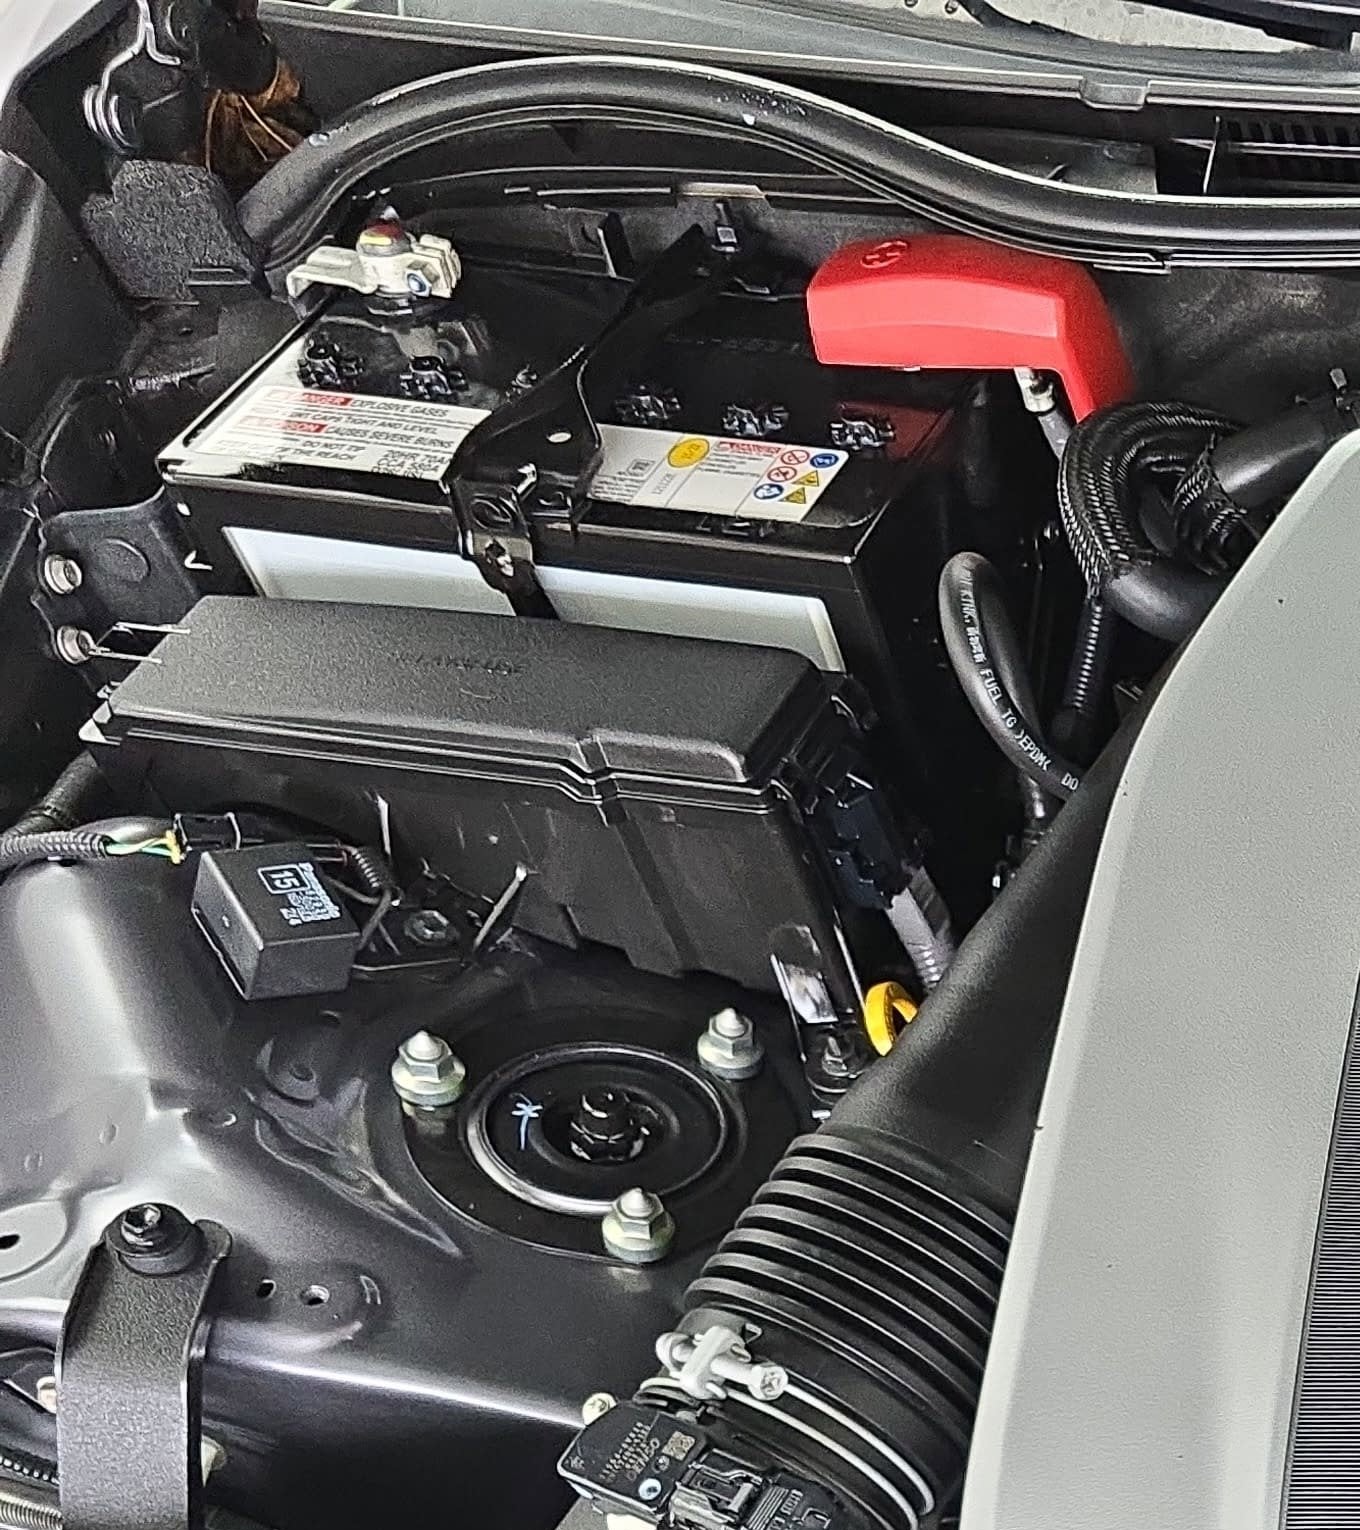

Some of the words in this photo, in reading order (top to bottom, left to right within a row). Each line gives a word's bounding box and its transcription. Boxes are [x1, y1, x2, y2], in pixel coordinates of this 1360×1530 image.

[352, 399, 410, 413] EXPLOSIVE
[411, 405, 449, 417] GASES
[325, 425, 367, 437] CAUSES
[368, 430, 412, 442] SEVERE
[401, 423, 438, 434] LEVEL
[979, 667, 1003, 706] FUEL
[1001, 708, 1018, 729] TG
[1061, 772, 1080, 791] DO
[268, 870, 301, 890] 15
